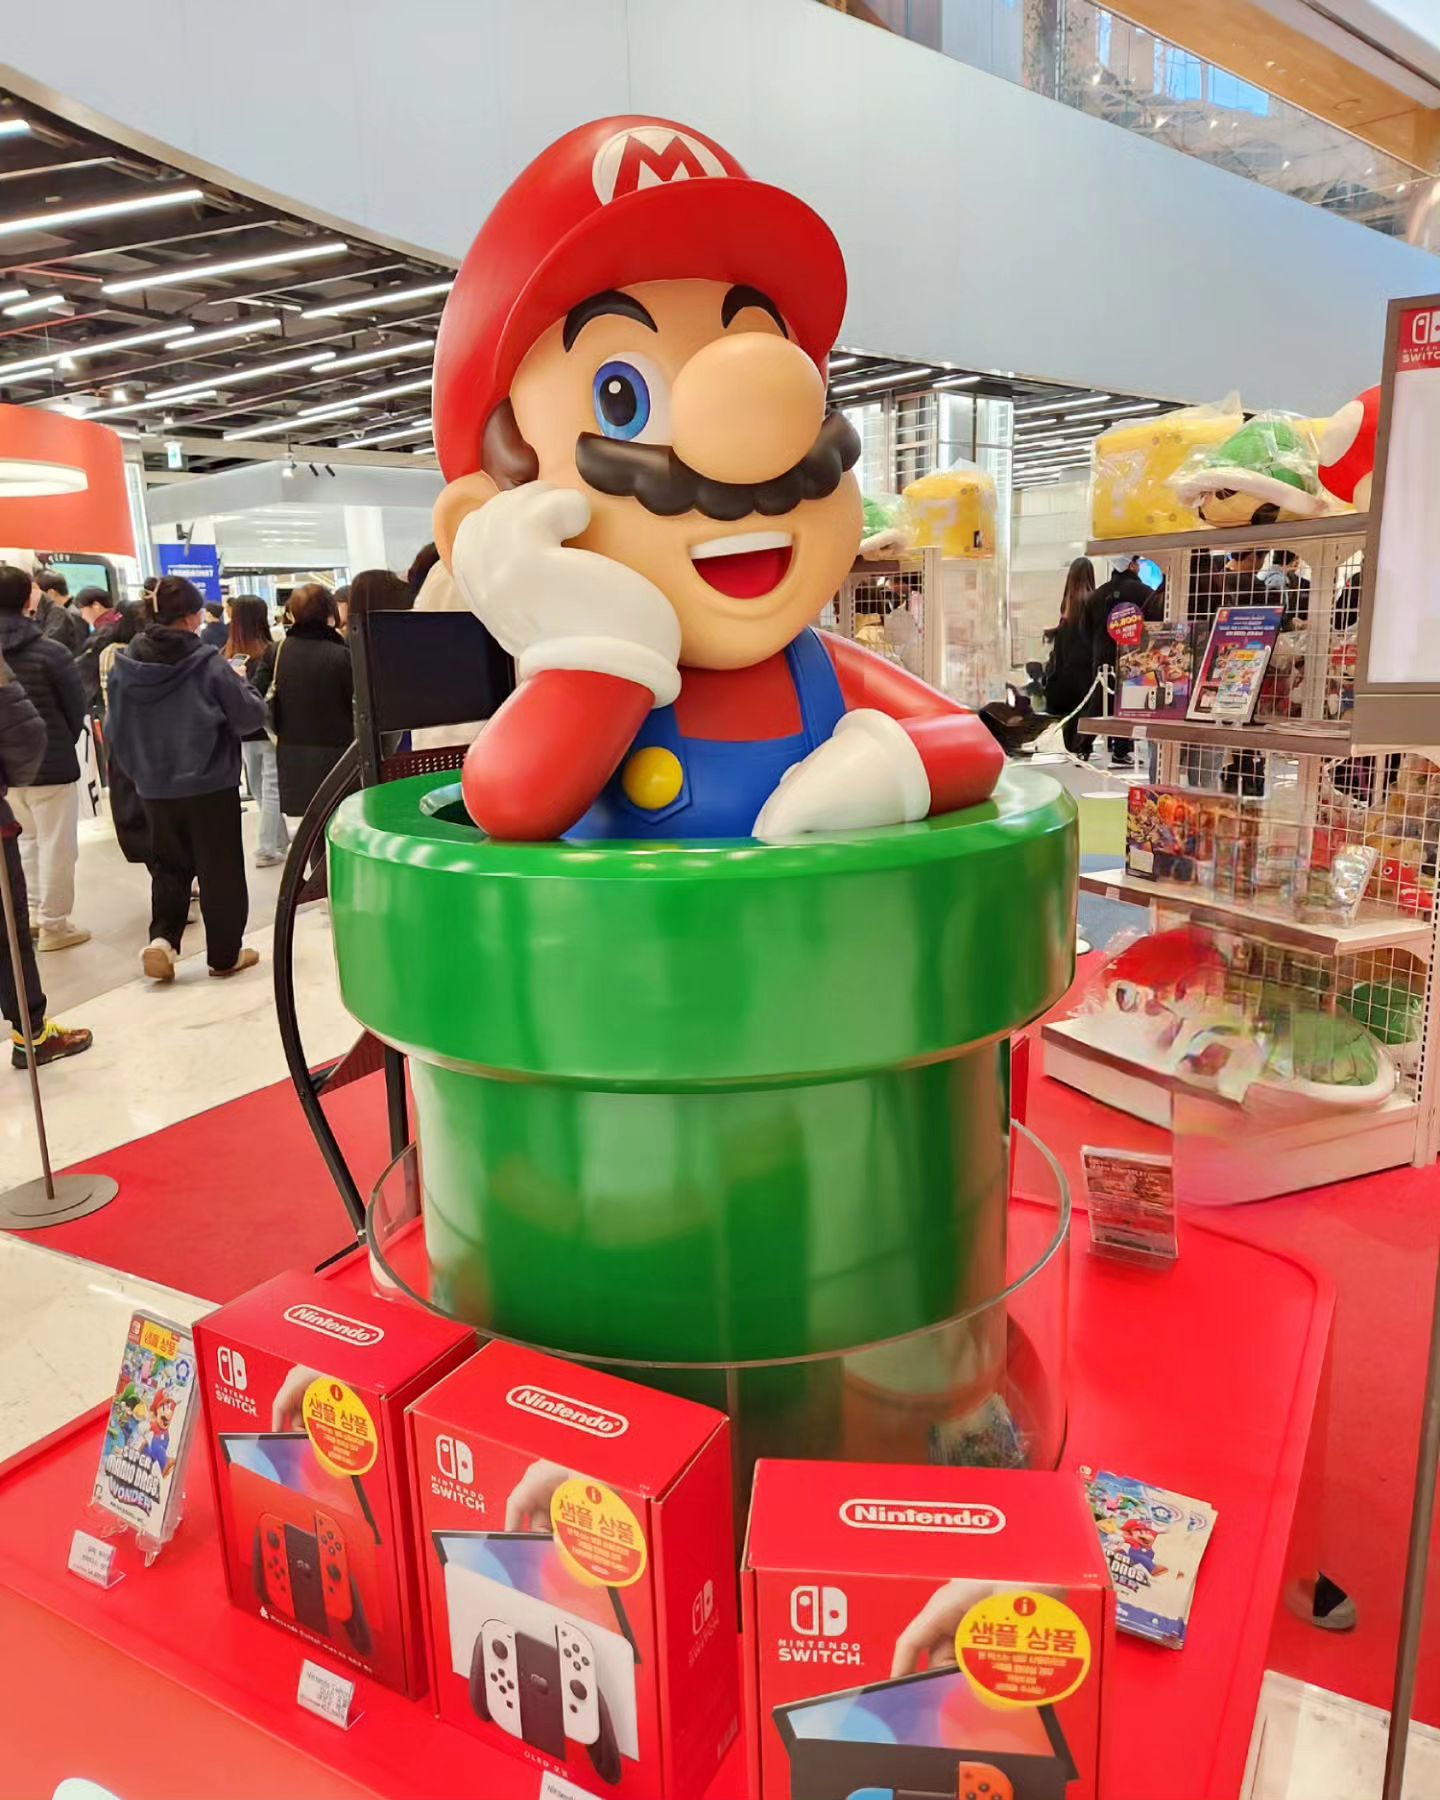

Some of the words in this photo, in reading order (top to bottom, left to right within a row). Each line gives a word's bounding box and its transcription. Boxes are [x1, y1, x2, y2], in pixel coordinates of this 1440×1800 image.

[611, 135, 709, 202] M
[1402, 350, 1440, 364] SWITC
[293, 1307, 371, 1341] Nintendo
[215, 1390, 257, 1417] SWITCH
[309, 1397, 336, 1425] 샘플
[341, 1409, 369, 1438] 상품
[517, 1389, 615, 1433] Nintendo
[431, 1475, 485, 1501] NINTENDO
[431, 1483, 486, 1514] SWITCH
[559, 1499, 593, 1530] 샘플
[598, 1513, 635, 1546] 상품
[854, 1504, 991, 1528] Nintendo
[778, 1639, 861, 1651] NINTENDO
[969, 1620, 1018, 1648] 샘플
[1026, 1626, 1077, 1654] 상품
[778, 1648, 862, 1666] SWITCH
